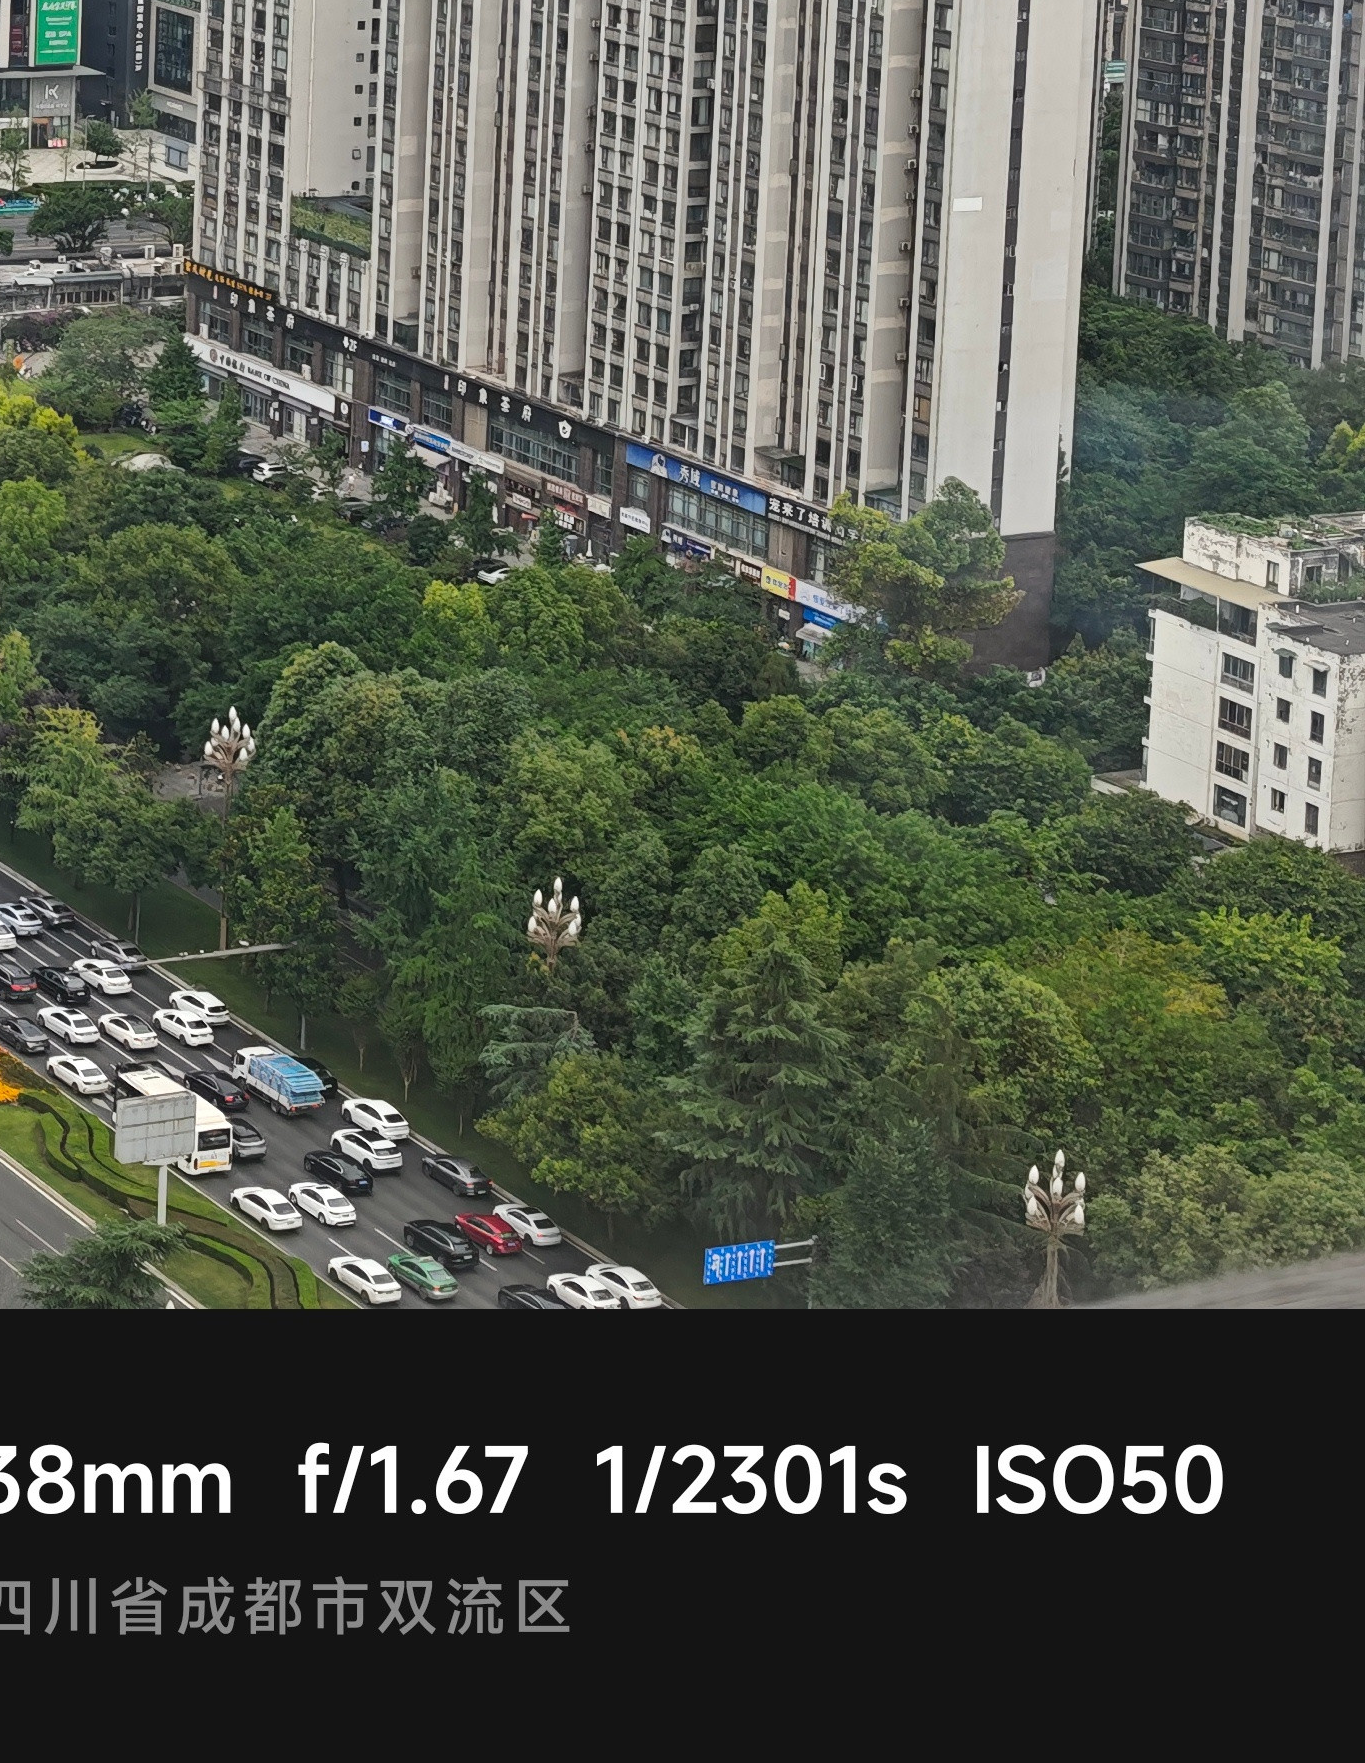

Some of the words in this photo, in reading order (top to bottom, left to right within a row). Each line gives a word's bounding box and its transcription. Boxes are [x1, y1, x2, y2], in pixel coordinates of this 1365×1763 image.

[219, 354, 246, 373] 中国银行
[247, 367, 263, 380] BANK
[263, 373, 272, 382] OF
[272, 376, 290, 391] CHINA
